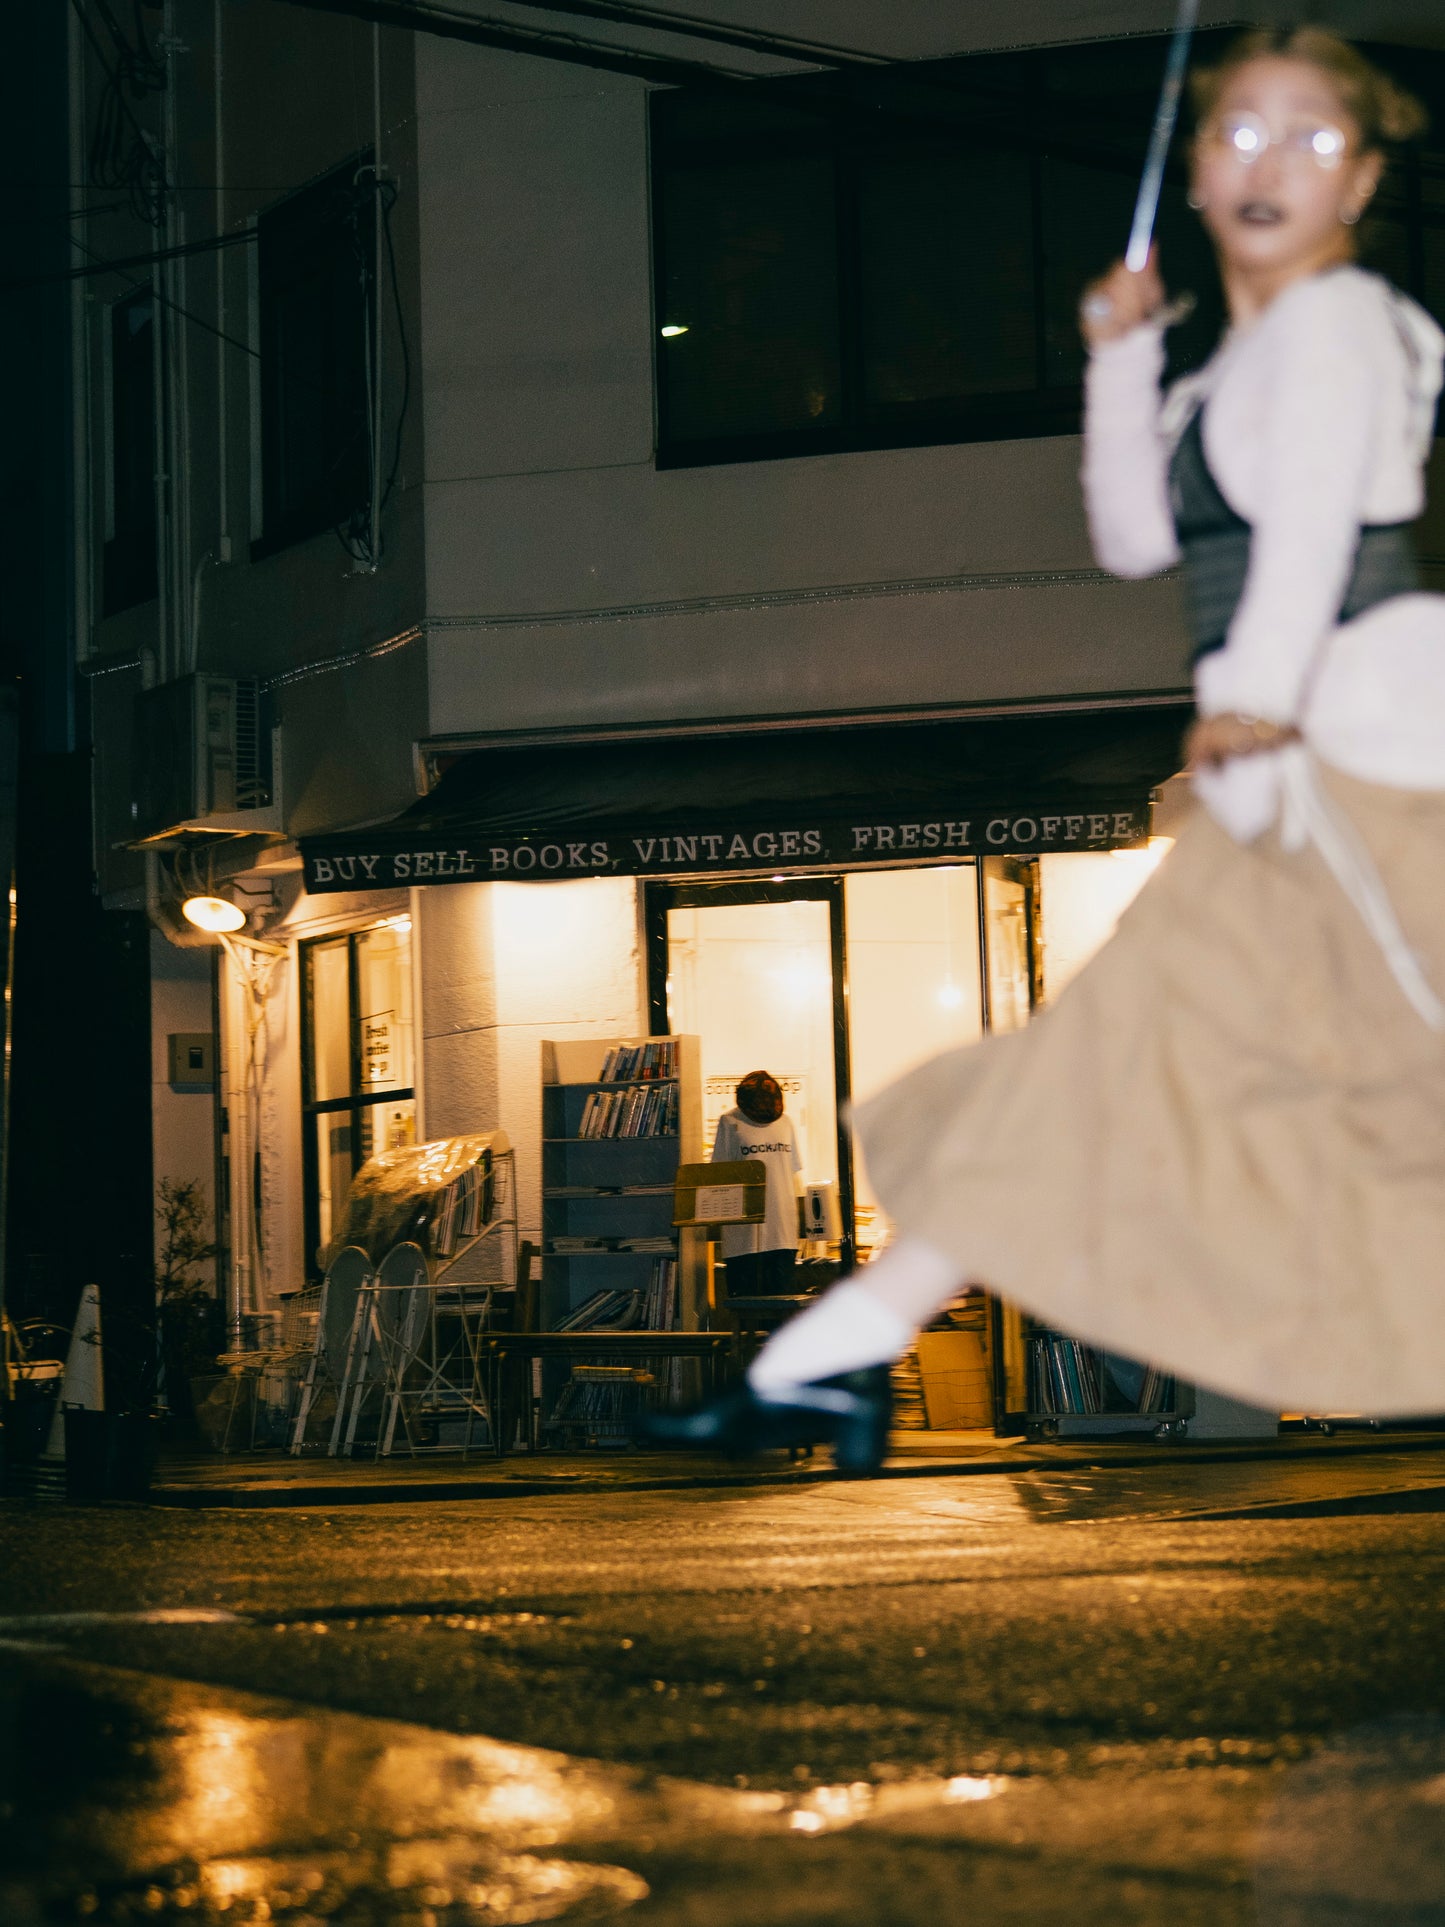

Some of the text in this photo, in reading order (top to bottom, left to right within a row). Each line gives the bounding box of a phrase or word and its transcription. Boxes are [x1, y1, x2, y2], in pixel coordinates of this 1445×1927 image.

[313, 813, 1135, 882] BUY SELL BOOKS, VINTAGES, FRESH COFFEE
